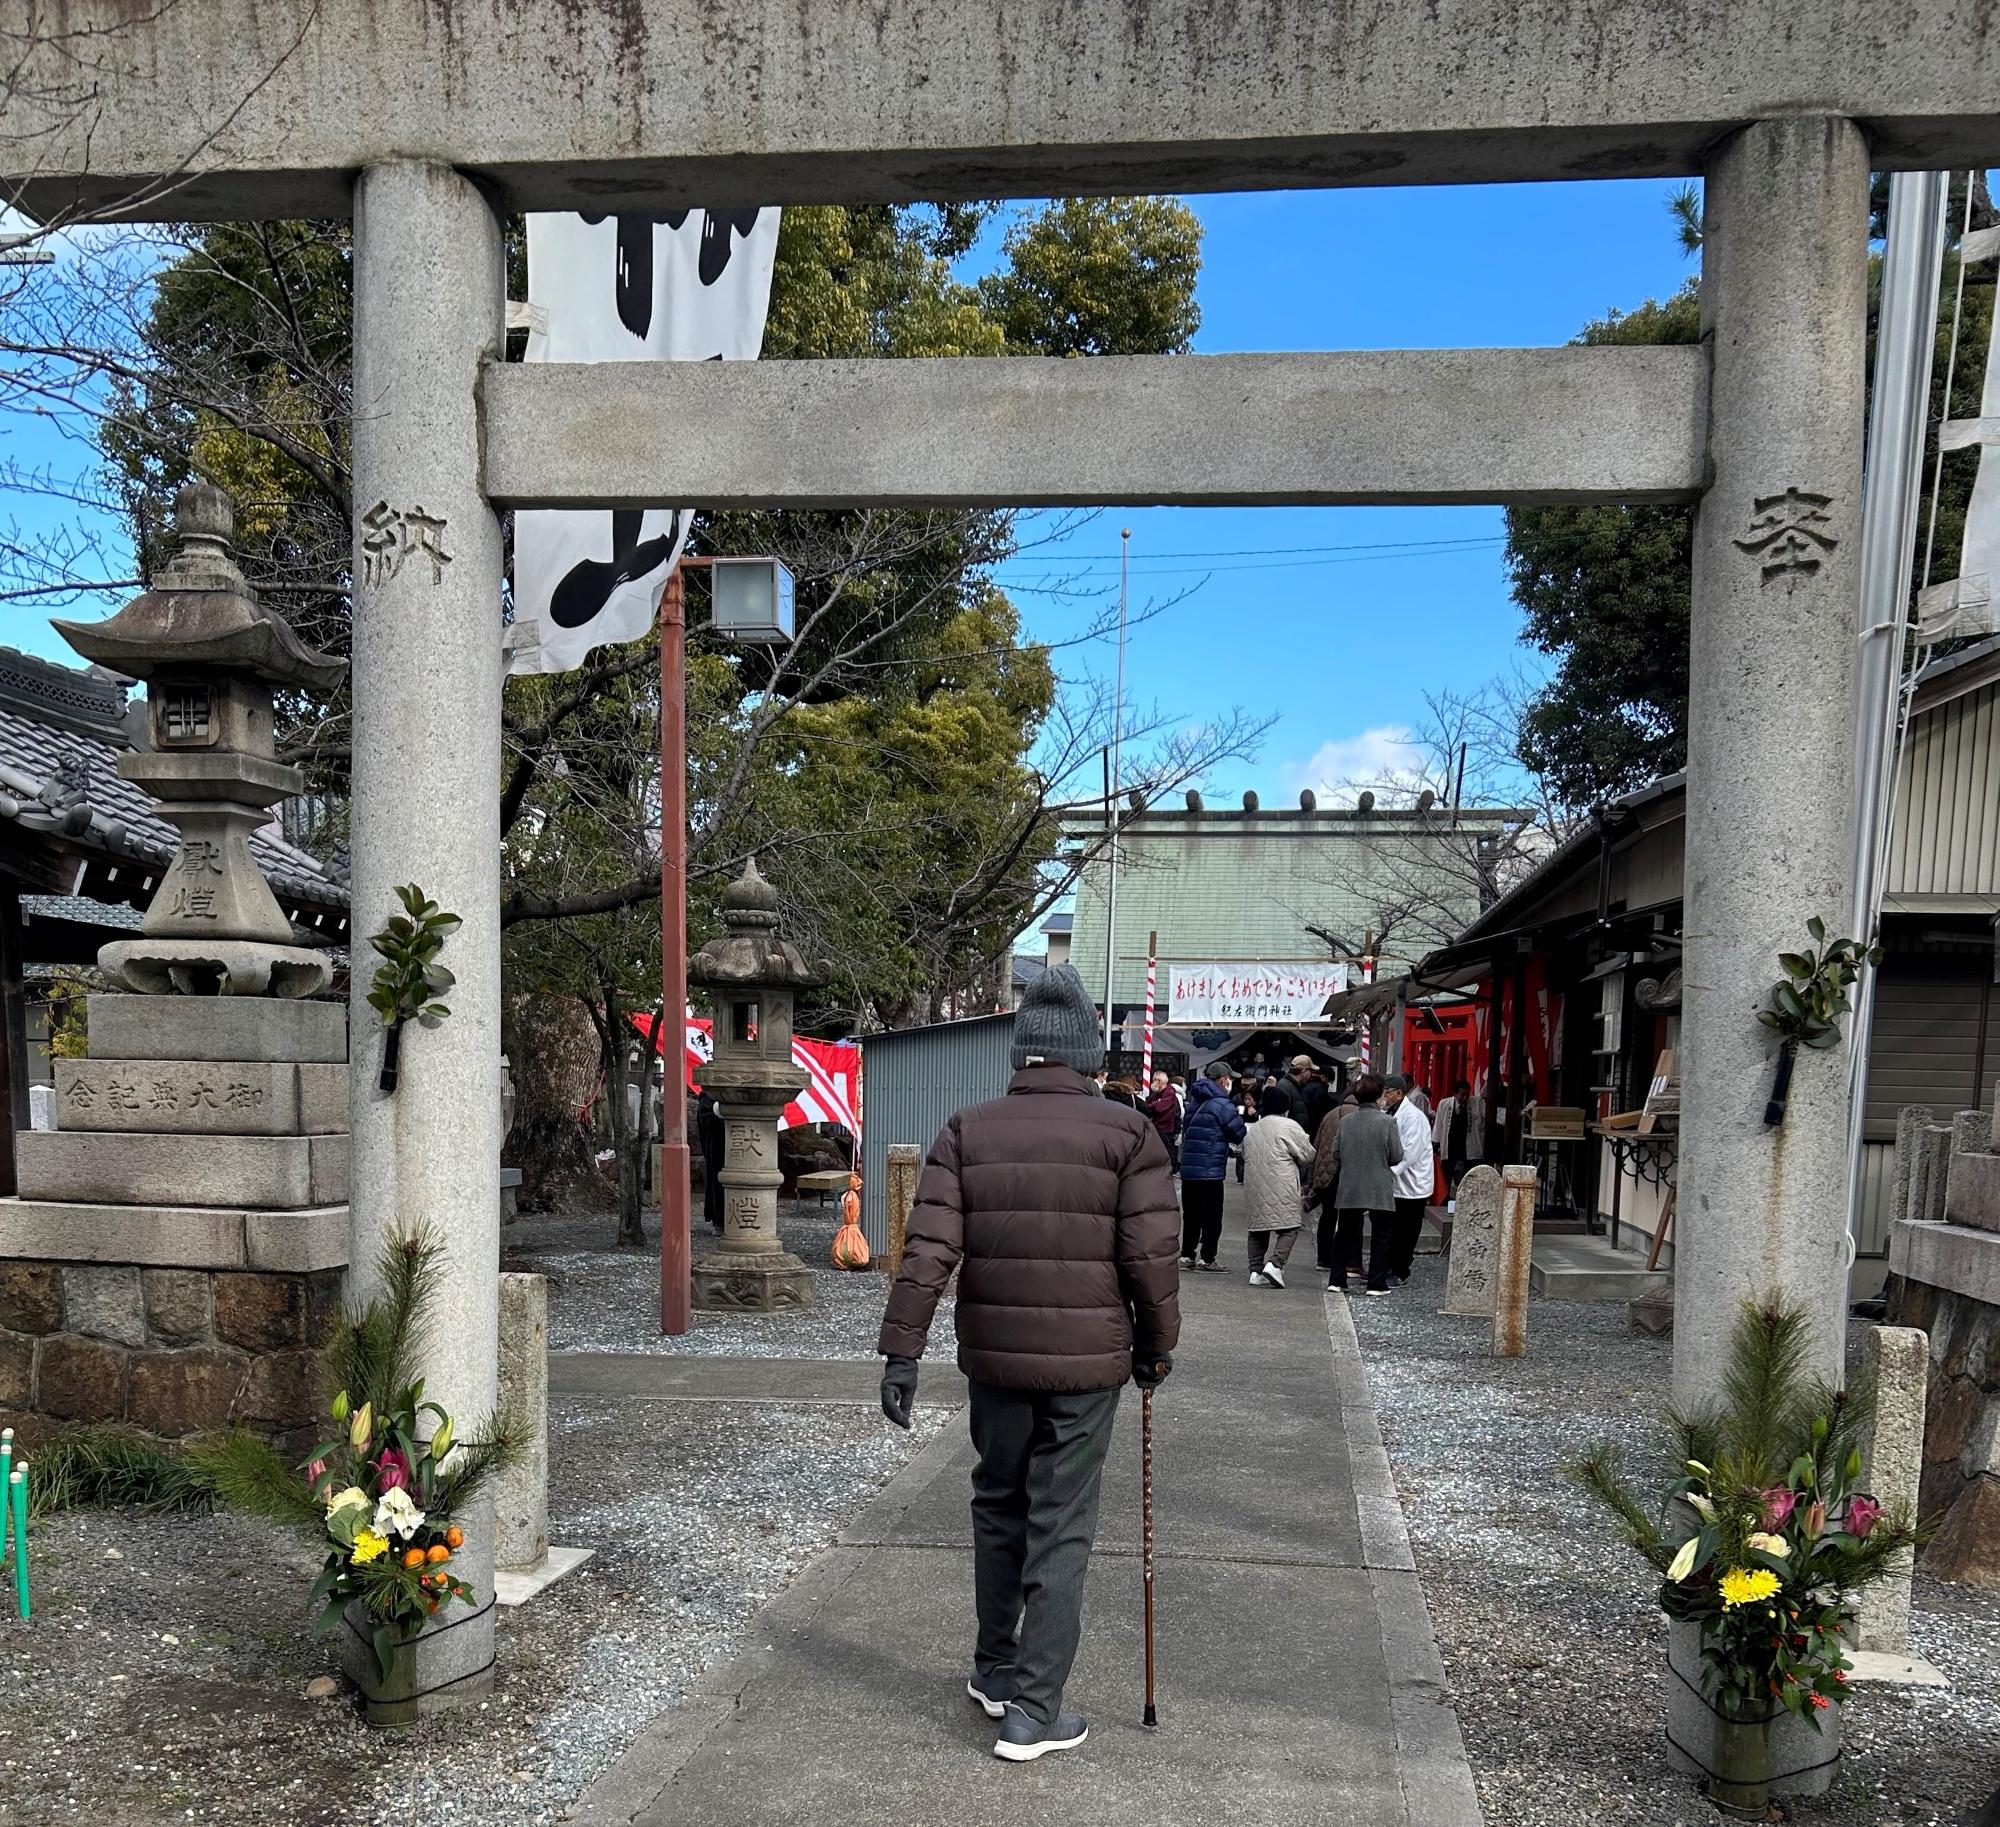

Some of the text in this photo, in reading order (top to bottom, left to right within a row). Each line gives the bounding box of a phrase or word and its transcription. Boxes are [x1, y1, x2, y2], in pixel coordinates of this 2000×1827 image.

[361, 500, 452, 592] 納
[1731, 486, 1839, 597] 奉
[1175, 976, 1339, 1000] あけましておめでとうございます
[1220, 1003, 1293, 1018] 紀左衛門神社
